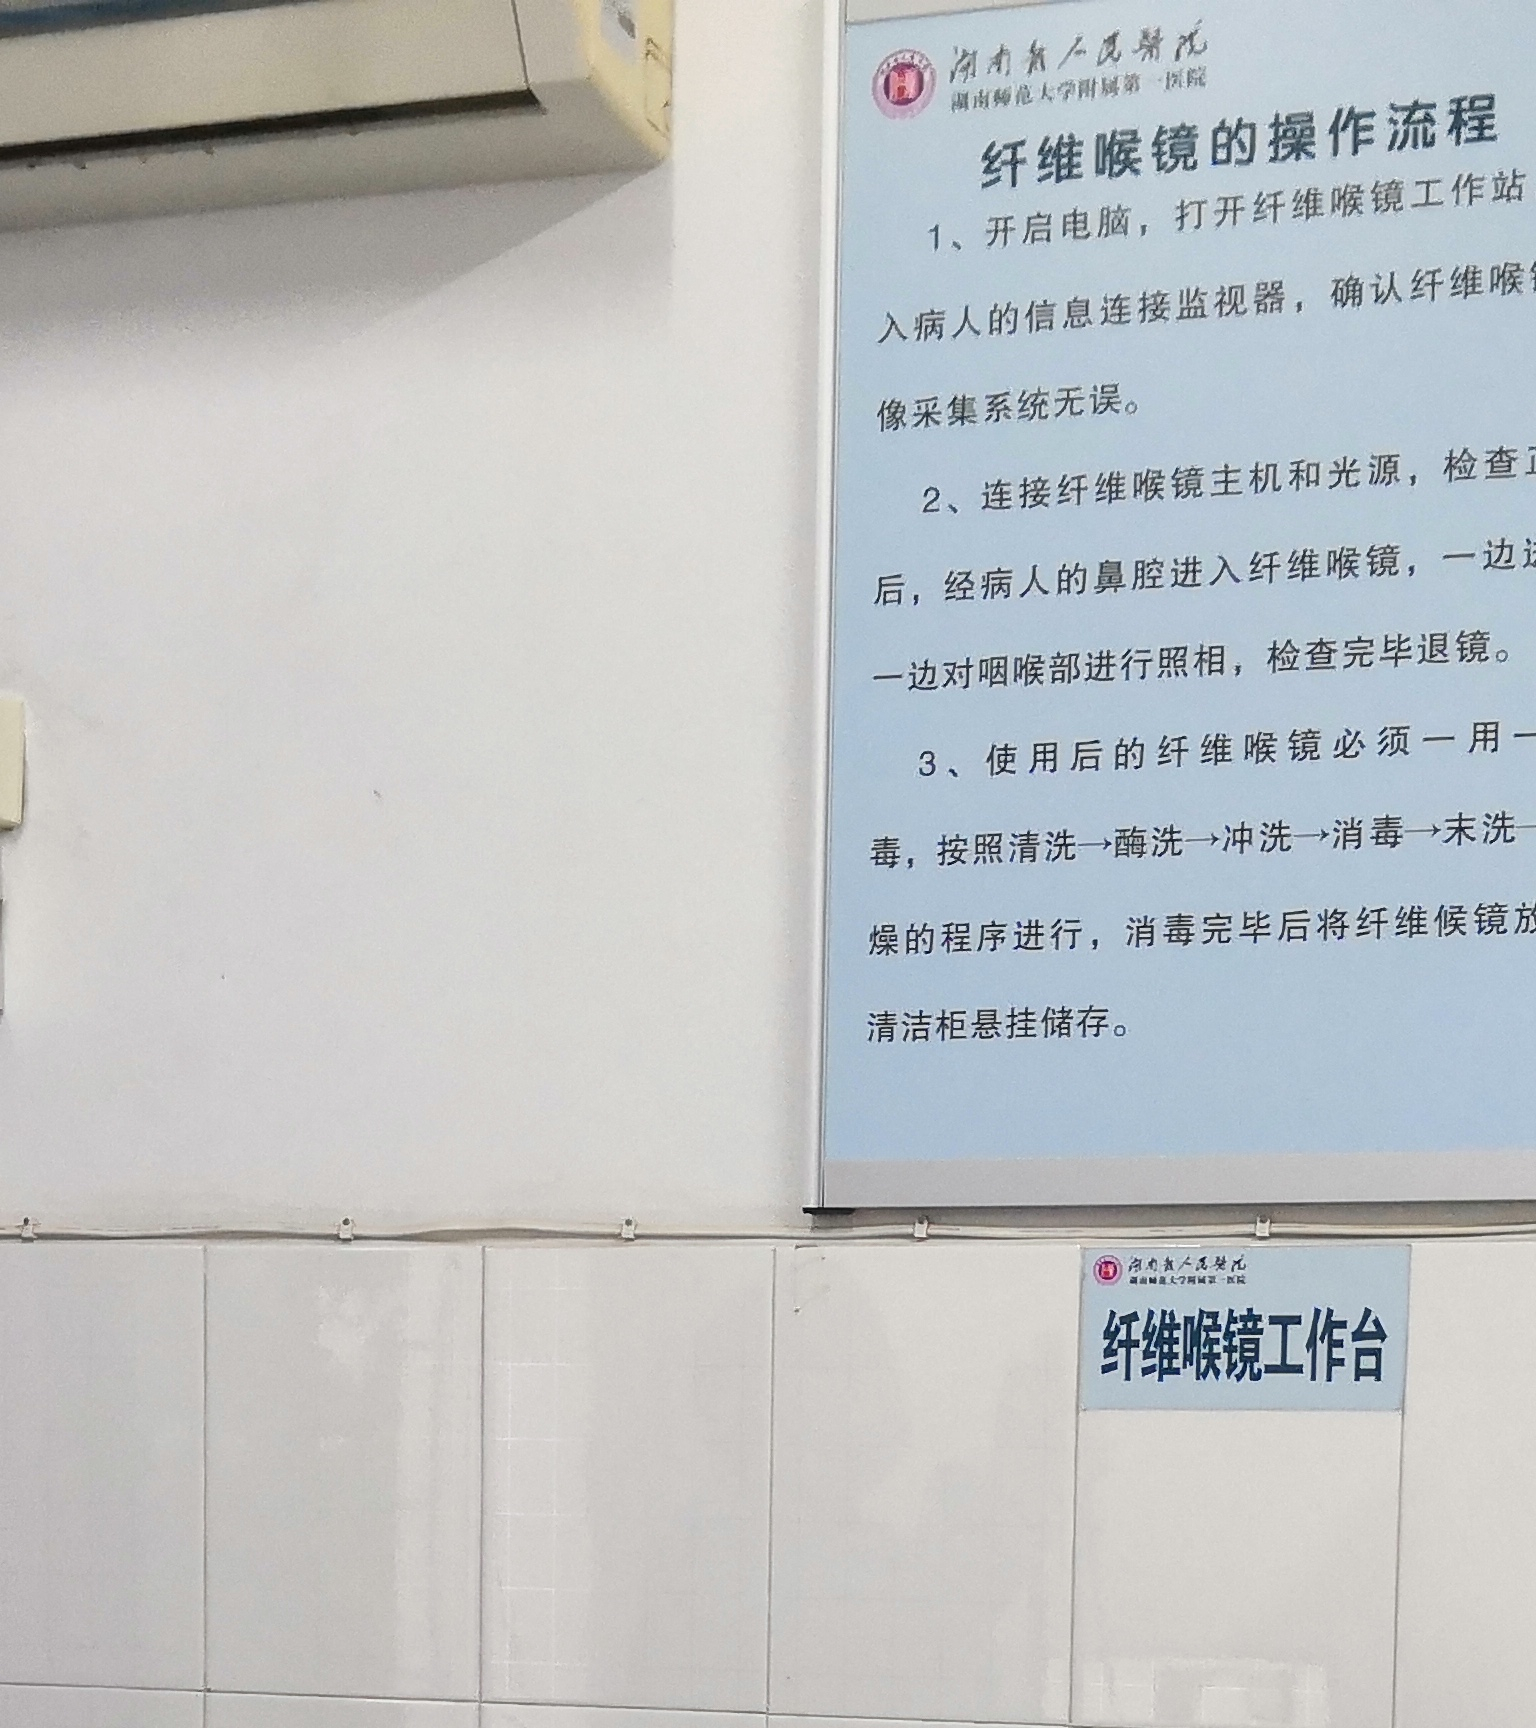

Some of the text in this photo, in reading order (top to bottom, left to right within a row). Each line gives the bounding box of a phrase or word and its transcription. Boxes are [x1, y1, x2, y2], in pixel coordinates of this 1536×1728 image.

[981, 93, 1497, 189] 纤维喉镜的操作流程
[877, 383, 1137, 432] 像采集系统无误。
[873, 630, 1508, 691] 一边对咽喉部进行照相，检查完毕退镜。
[867, 1005, 1126, 1043] 清洁柜悬挂储存。
[1101, 1307, 1387, 1382] 纤维喉镜工作台
